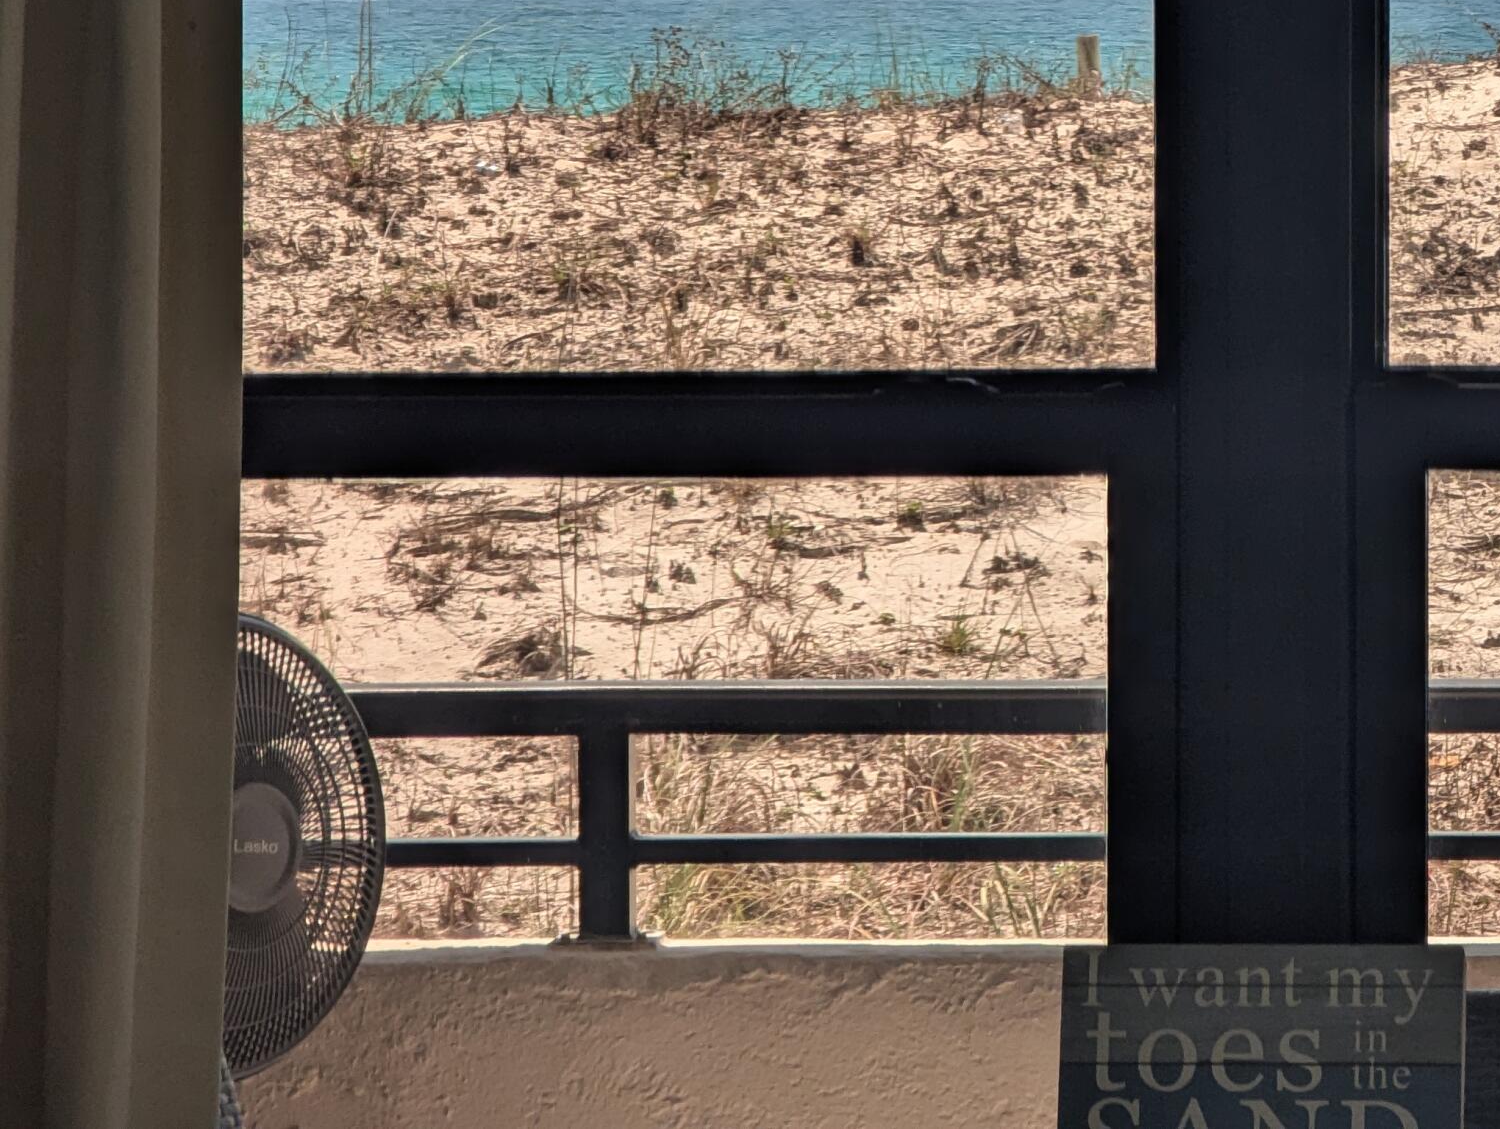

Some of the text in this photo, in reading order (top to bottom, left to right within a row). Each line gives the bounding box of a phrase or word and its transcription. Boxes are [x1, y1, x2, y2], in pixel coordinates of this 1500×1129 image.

[234, 838, 279, 855] Lasko
[1080, 952, 1434, 1025] I want my
[1086, 1011, 1324, 1093] toes
[1353, 1020, 1388, 1053] in
[1352, 1057, 1413, 1090] the
